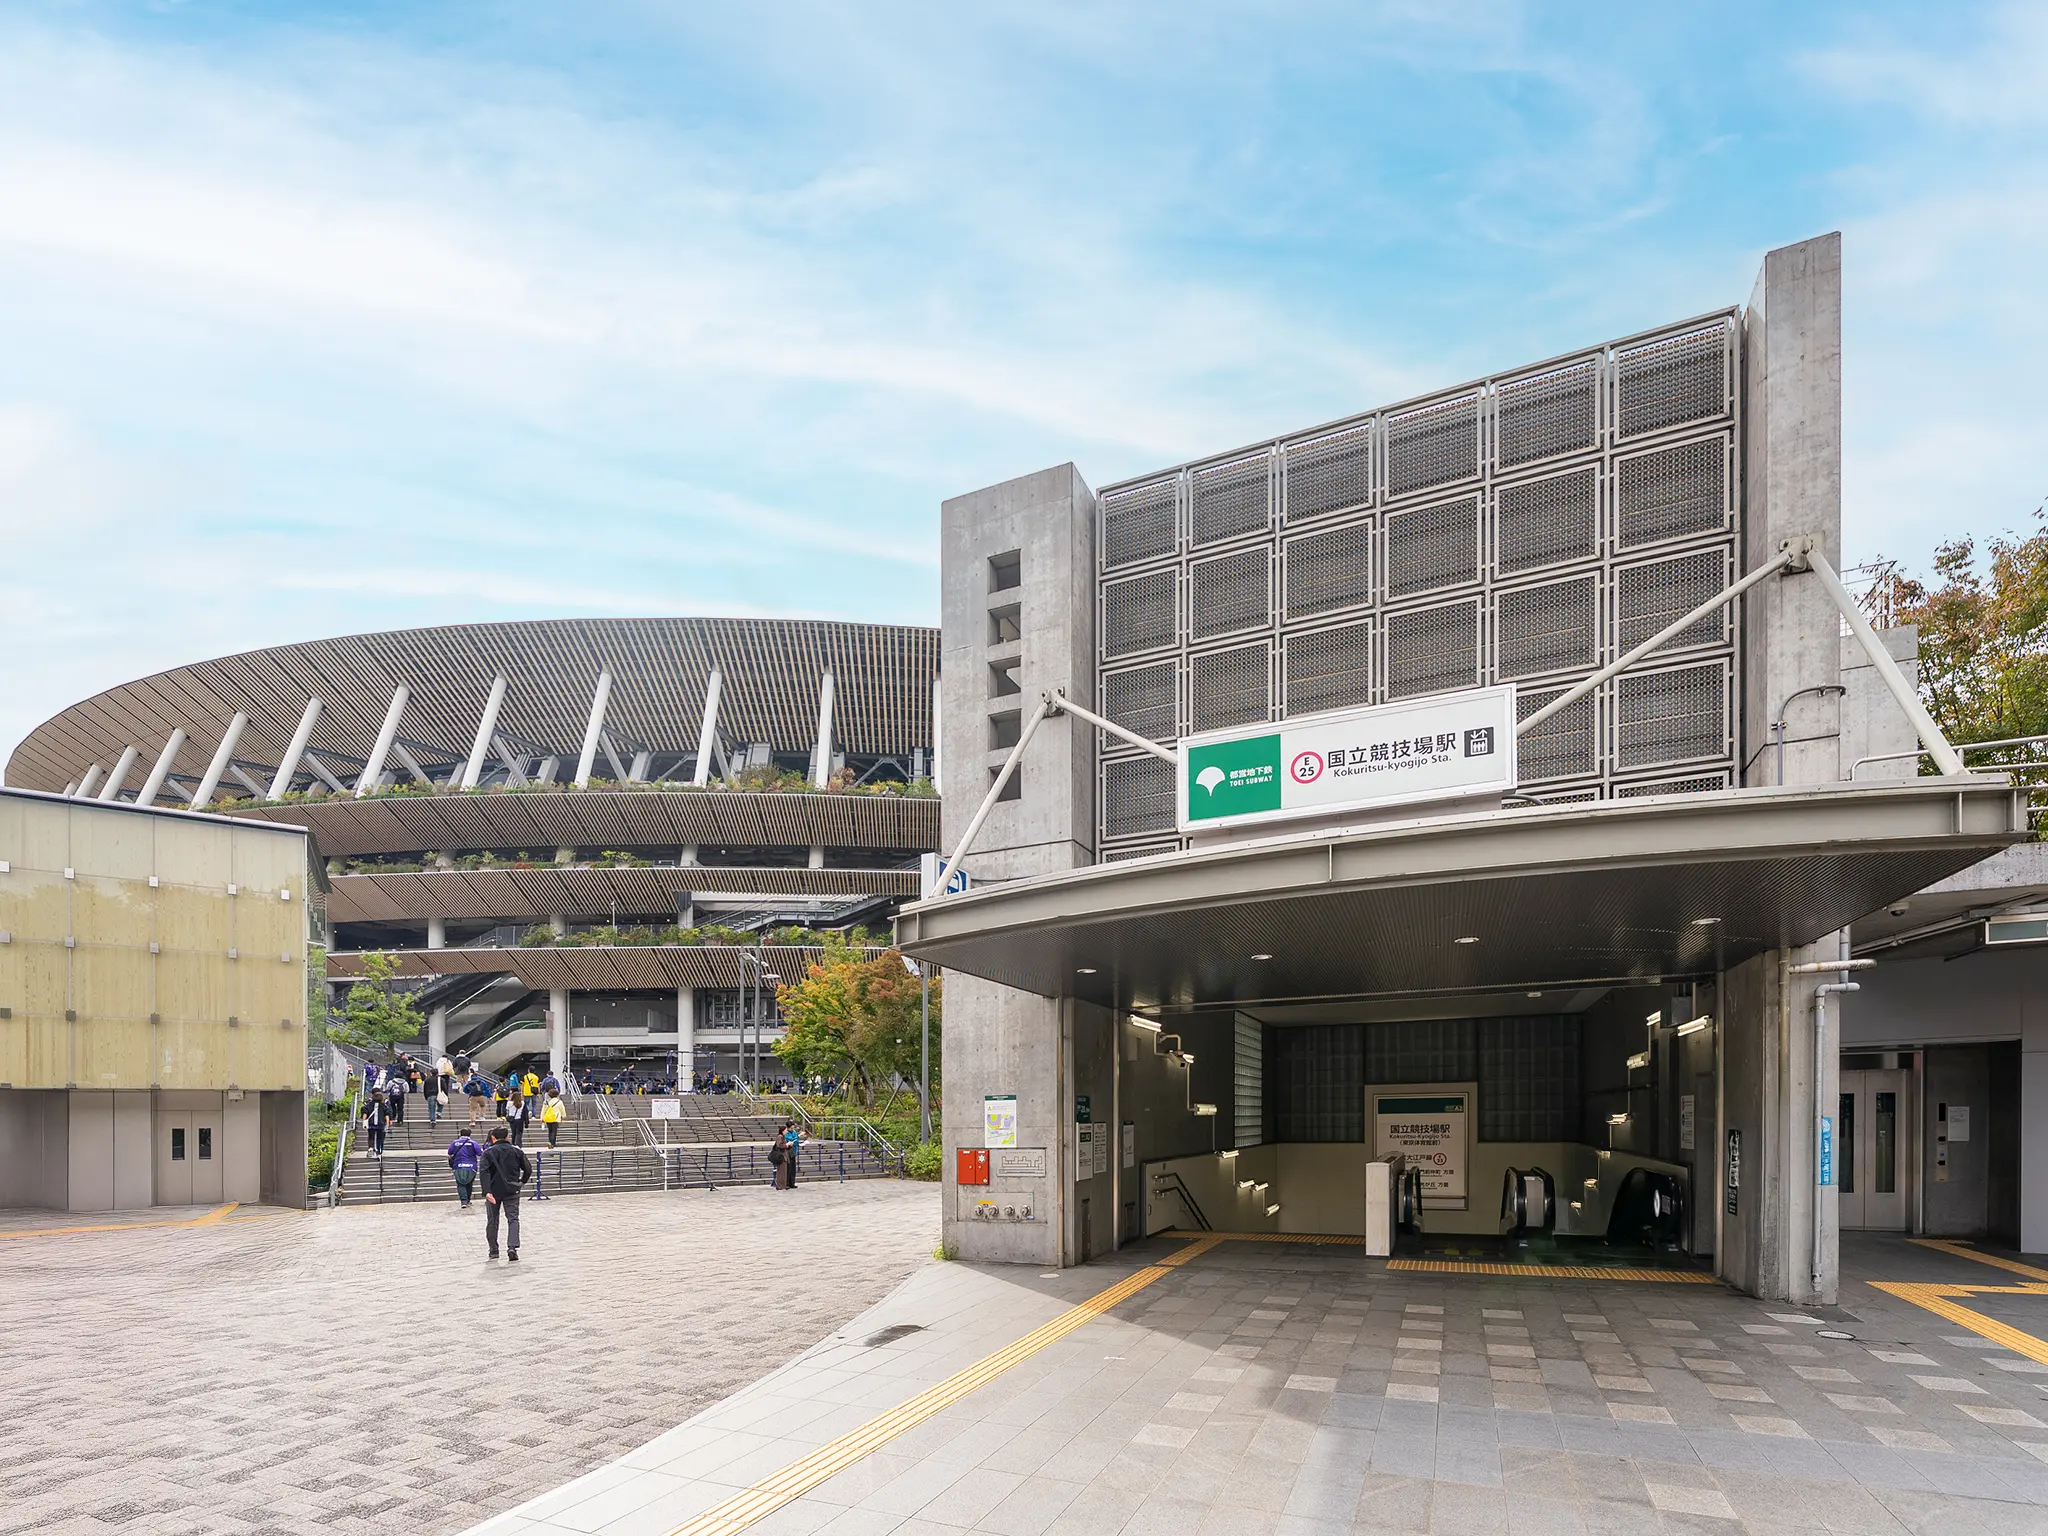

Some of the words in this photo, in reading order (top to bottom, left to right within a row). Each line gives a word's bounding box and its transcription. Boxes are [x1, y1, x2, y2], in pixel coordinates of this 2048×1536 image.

[1328, 732, 1457, 769] 国立競技場駅
[1304, 756, 1310, 766] E
[1333, 756, 1428, 778] Kokuritsu-kyogijo
[1431, 754, 1452, 764] Sta.
[1229, 765, 1273, 780] 都営地下鉄
[1299, 766, 1315, 777] 25
[1229, 779, 1244, 787] TOEI
[1246, 775, 1273, 786] SUBWAY
[1390, 1124, 1451, 1134] 国立競技場駅
